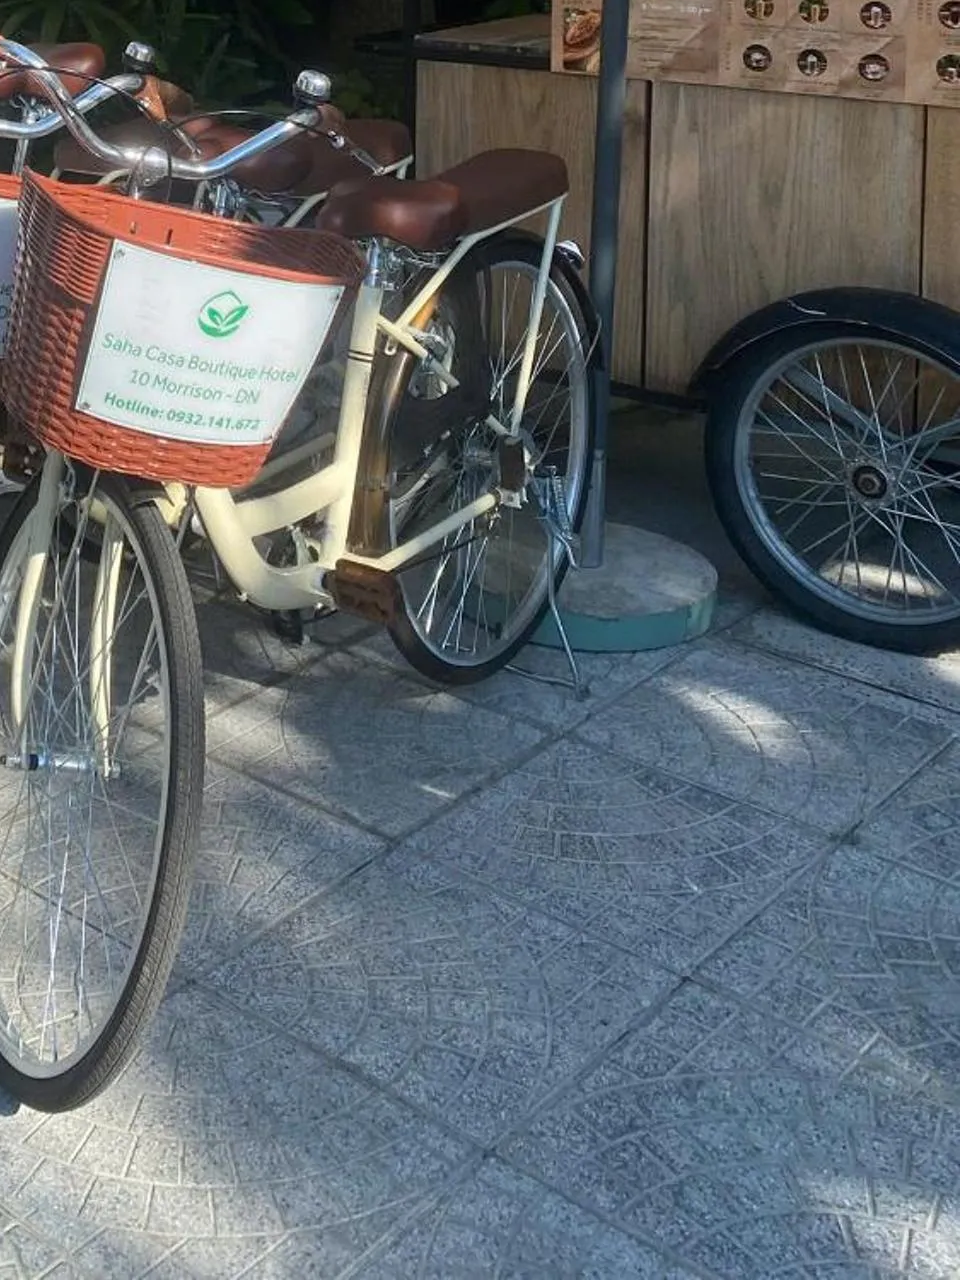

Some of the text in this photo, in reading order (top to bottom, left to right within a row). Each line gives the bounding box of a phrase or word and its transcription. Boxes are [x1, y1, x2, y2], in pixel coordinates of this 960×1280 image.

[101, 332, 300, 383] Saha Casa Boutique Hotel
[104, 390, 165, 419] Hotline:
[129, 369, 151, 387] 10
[151, 373, 223, 402] Morrison
[234, 388, 261, 405] DN
